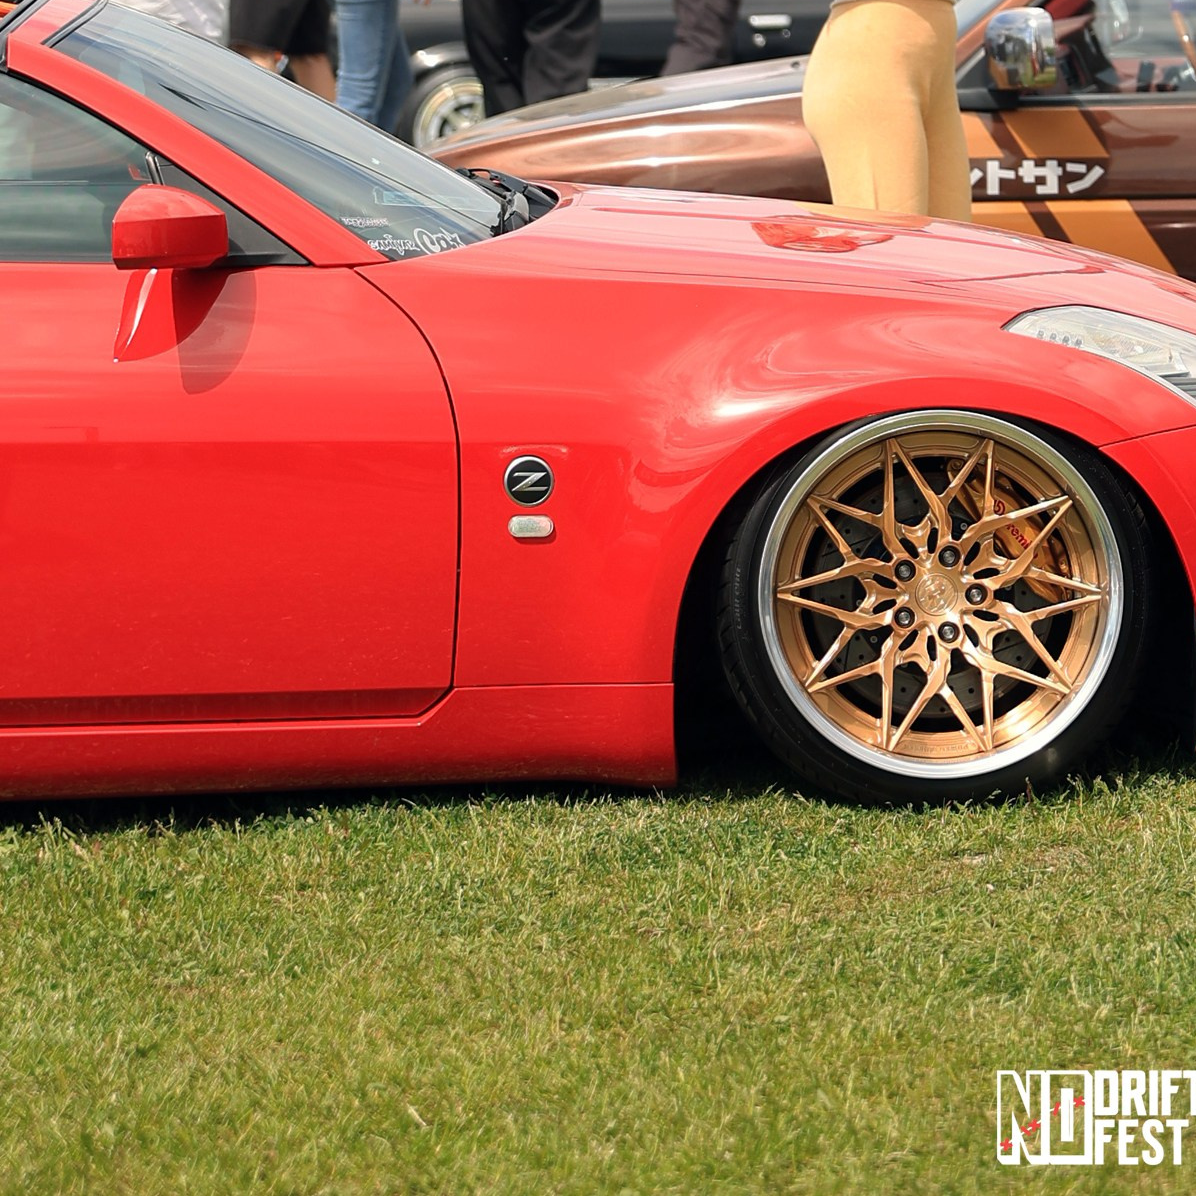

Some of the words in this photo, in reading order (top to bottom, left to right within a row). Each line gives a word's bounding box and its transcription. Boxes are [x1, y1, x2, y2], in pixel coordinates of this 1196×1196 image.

[970, 159, 1105, 196] トサン
[511, 471, 548, 492] Z
